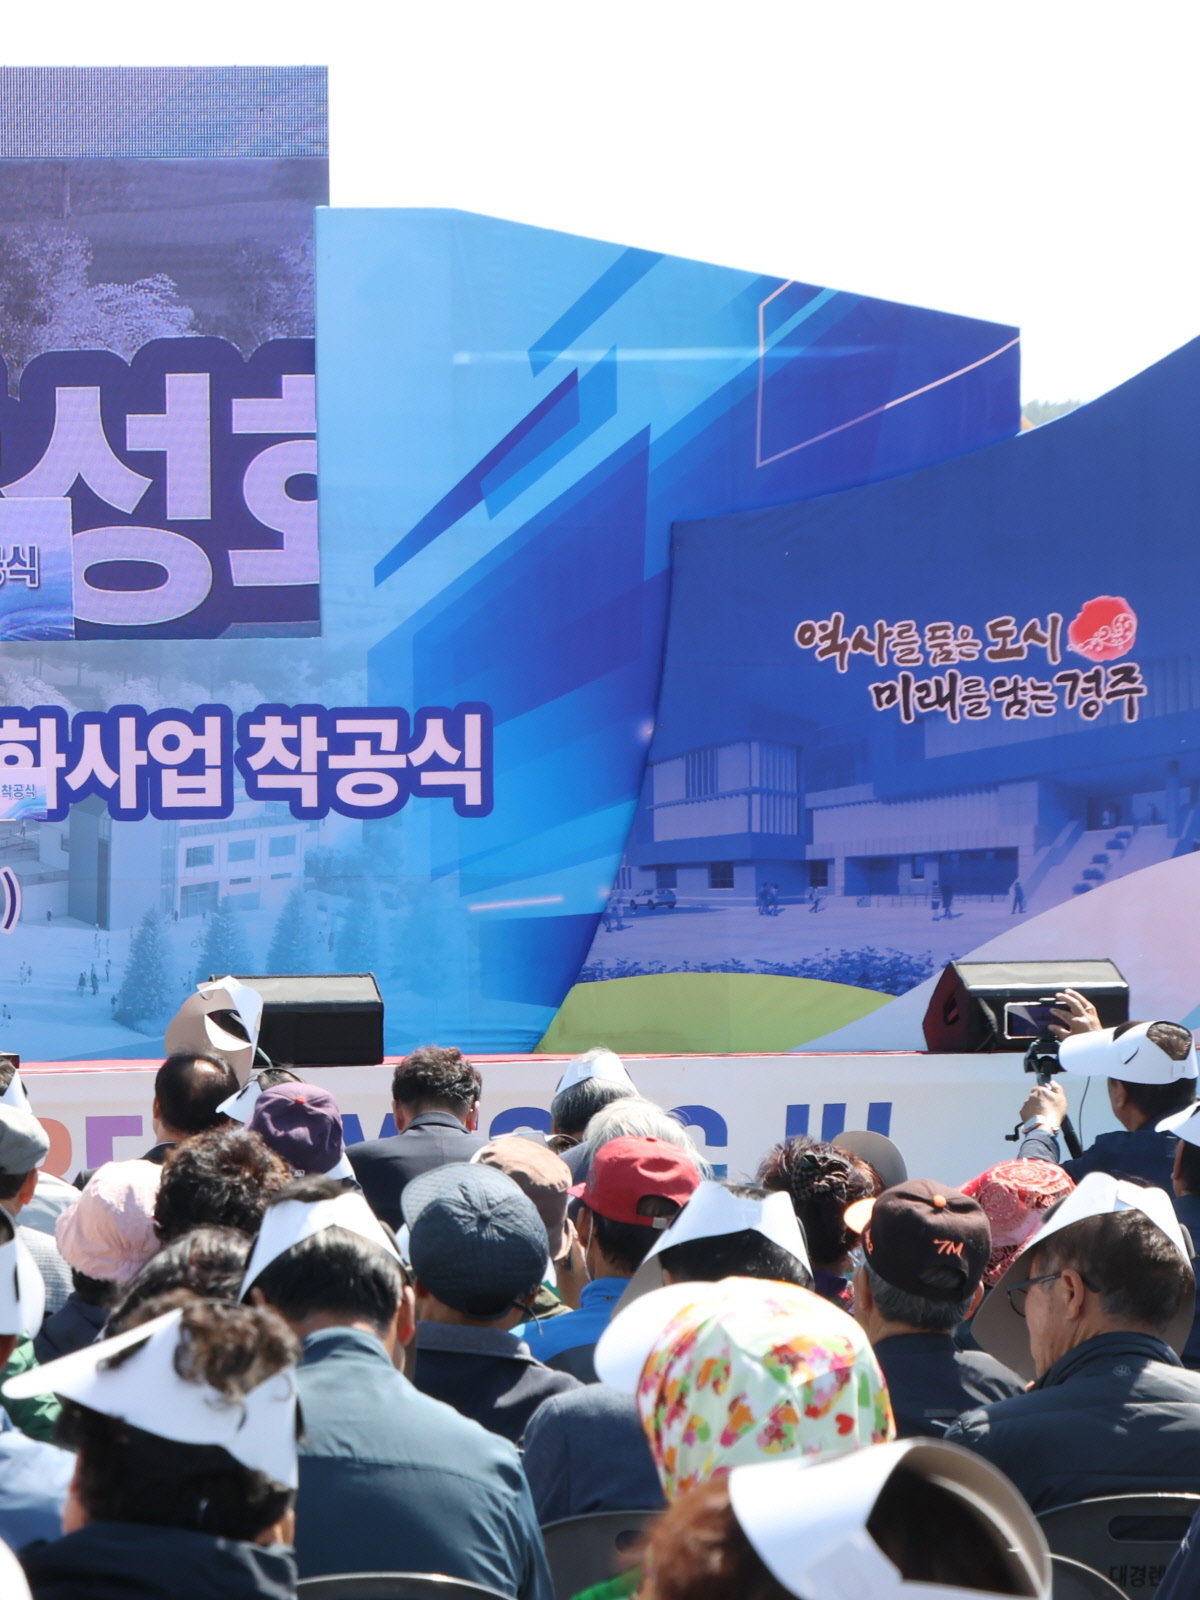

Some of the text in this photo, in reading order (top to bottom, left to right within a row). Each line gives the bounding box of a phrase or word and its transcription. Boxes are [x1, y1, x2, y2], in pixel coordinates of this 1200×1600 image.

[795, 612, 1063, 673] 역사를 품은 도시
[869, 662, 1147, 723] 미래를 담는 경주
[1, 783, 36, 799] 착공식
[243, 711, 485, 810] 착공식
